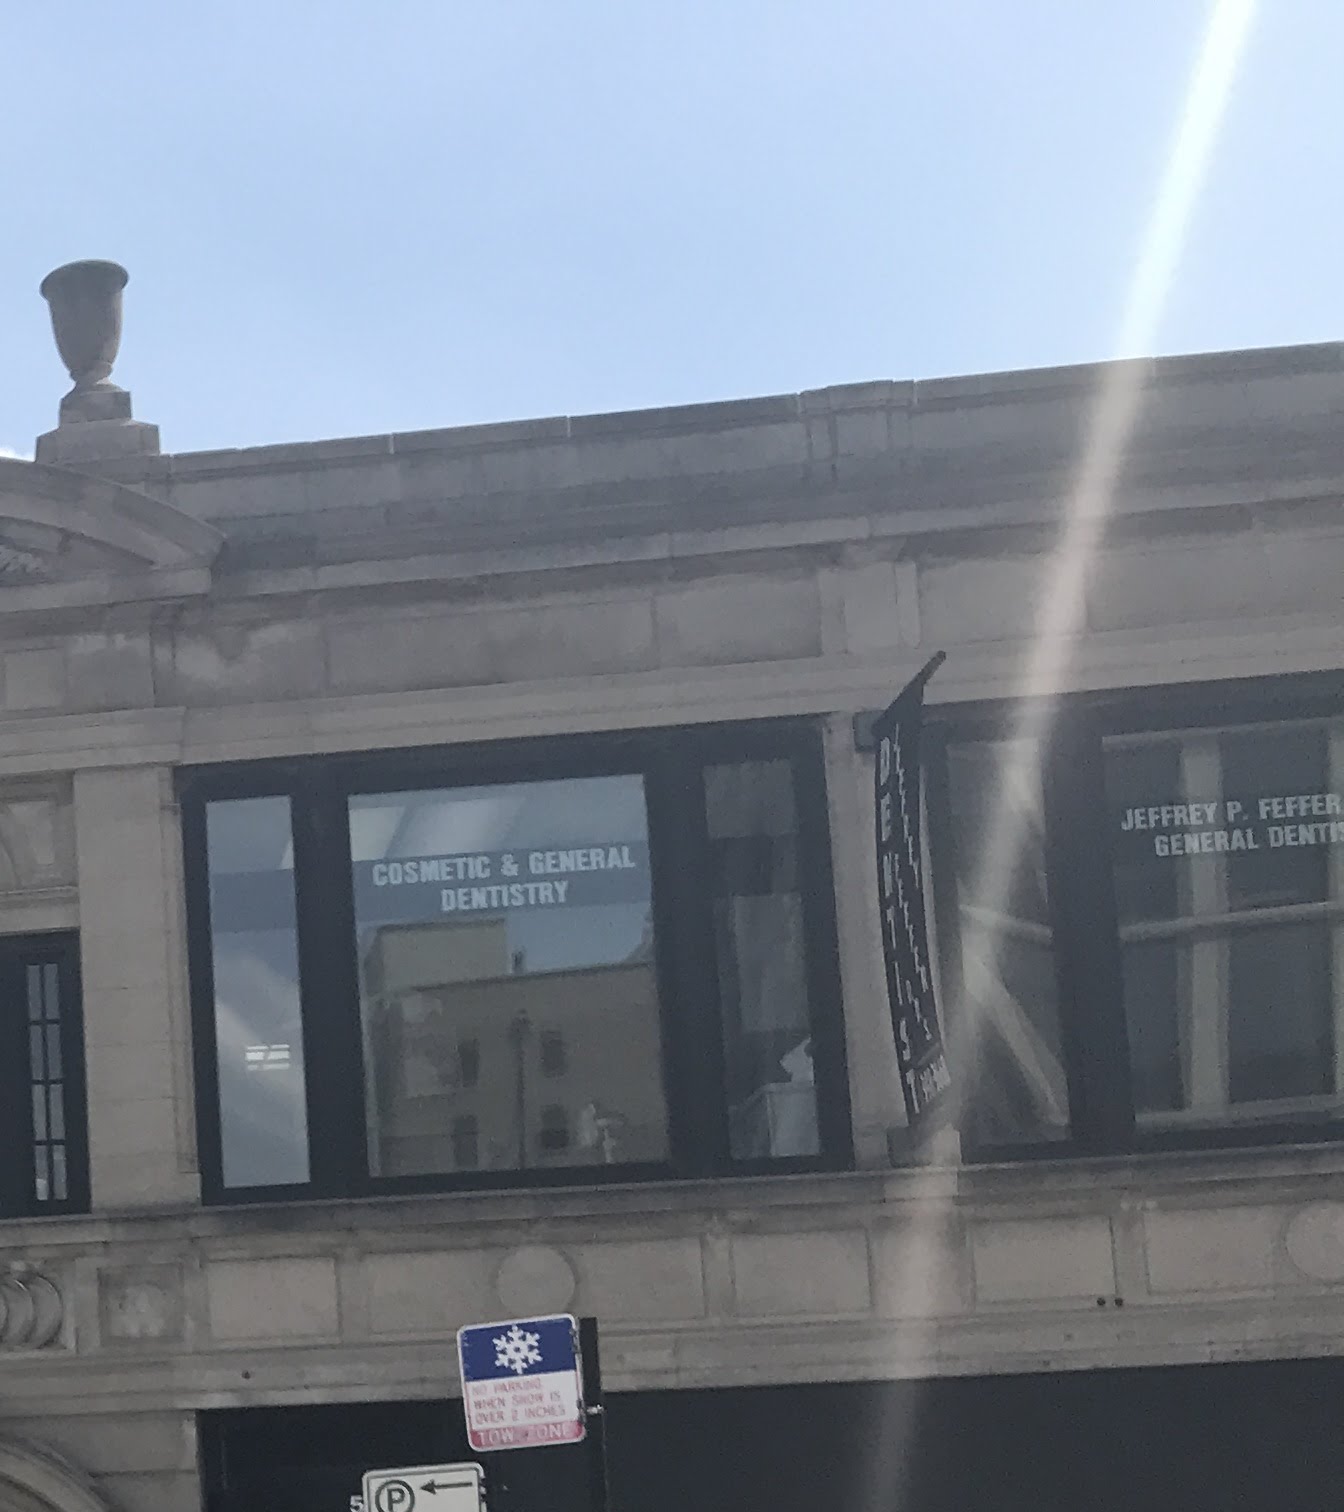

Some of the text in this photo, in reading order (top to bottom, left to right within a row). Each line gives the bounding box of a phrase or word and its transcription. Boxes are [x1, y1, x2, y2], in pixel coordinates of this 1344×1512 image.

[1121, 802, 1217, 831] JEFFREY
[1227, 801, 1248, 822] P.
[1155, 828, 1259, 857] GENERAL
[372, 846, 636, 886] COSMETIC & GENERAL
[441, 880, 569, 911] DENTISTRY
